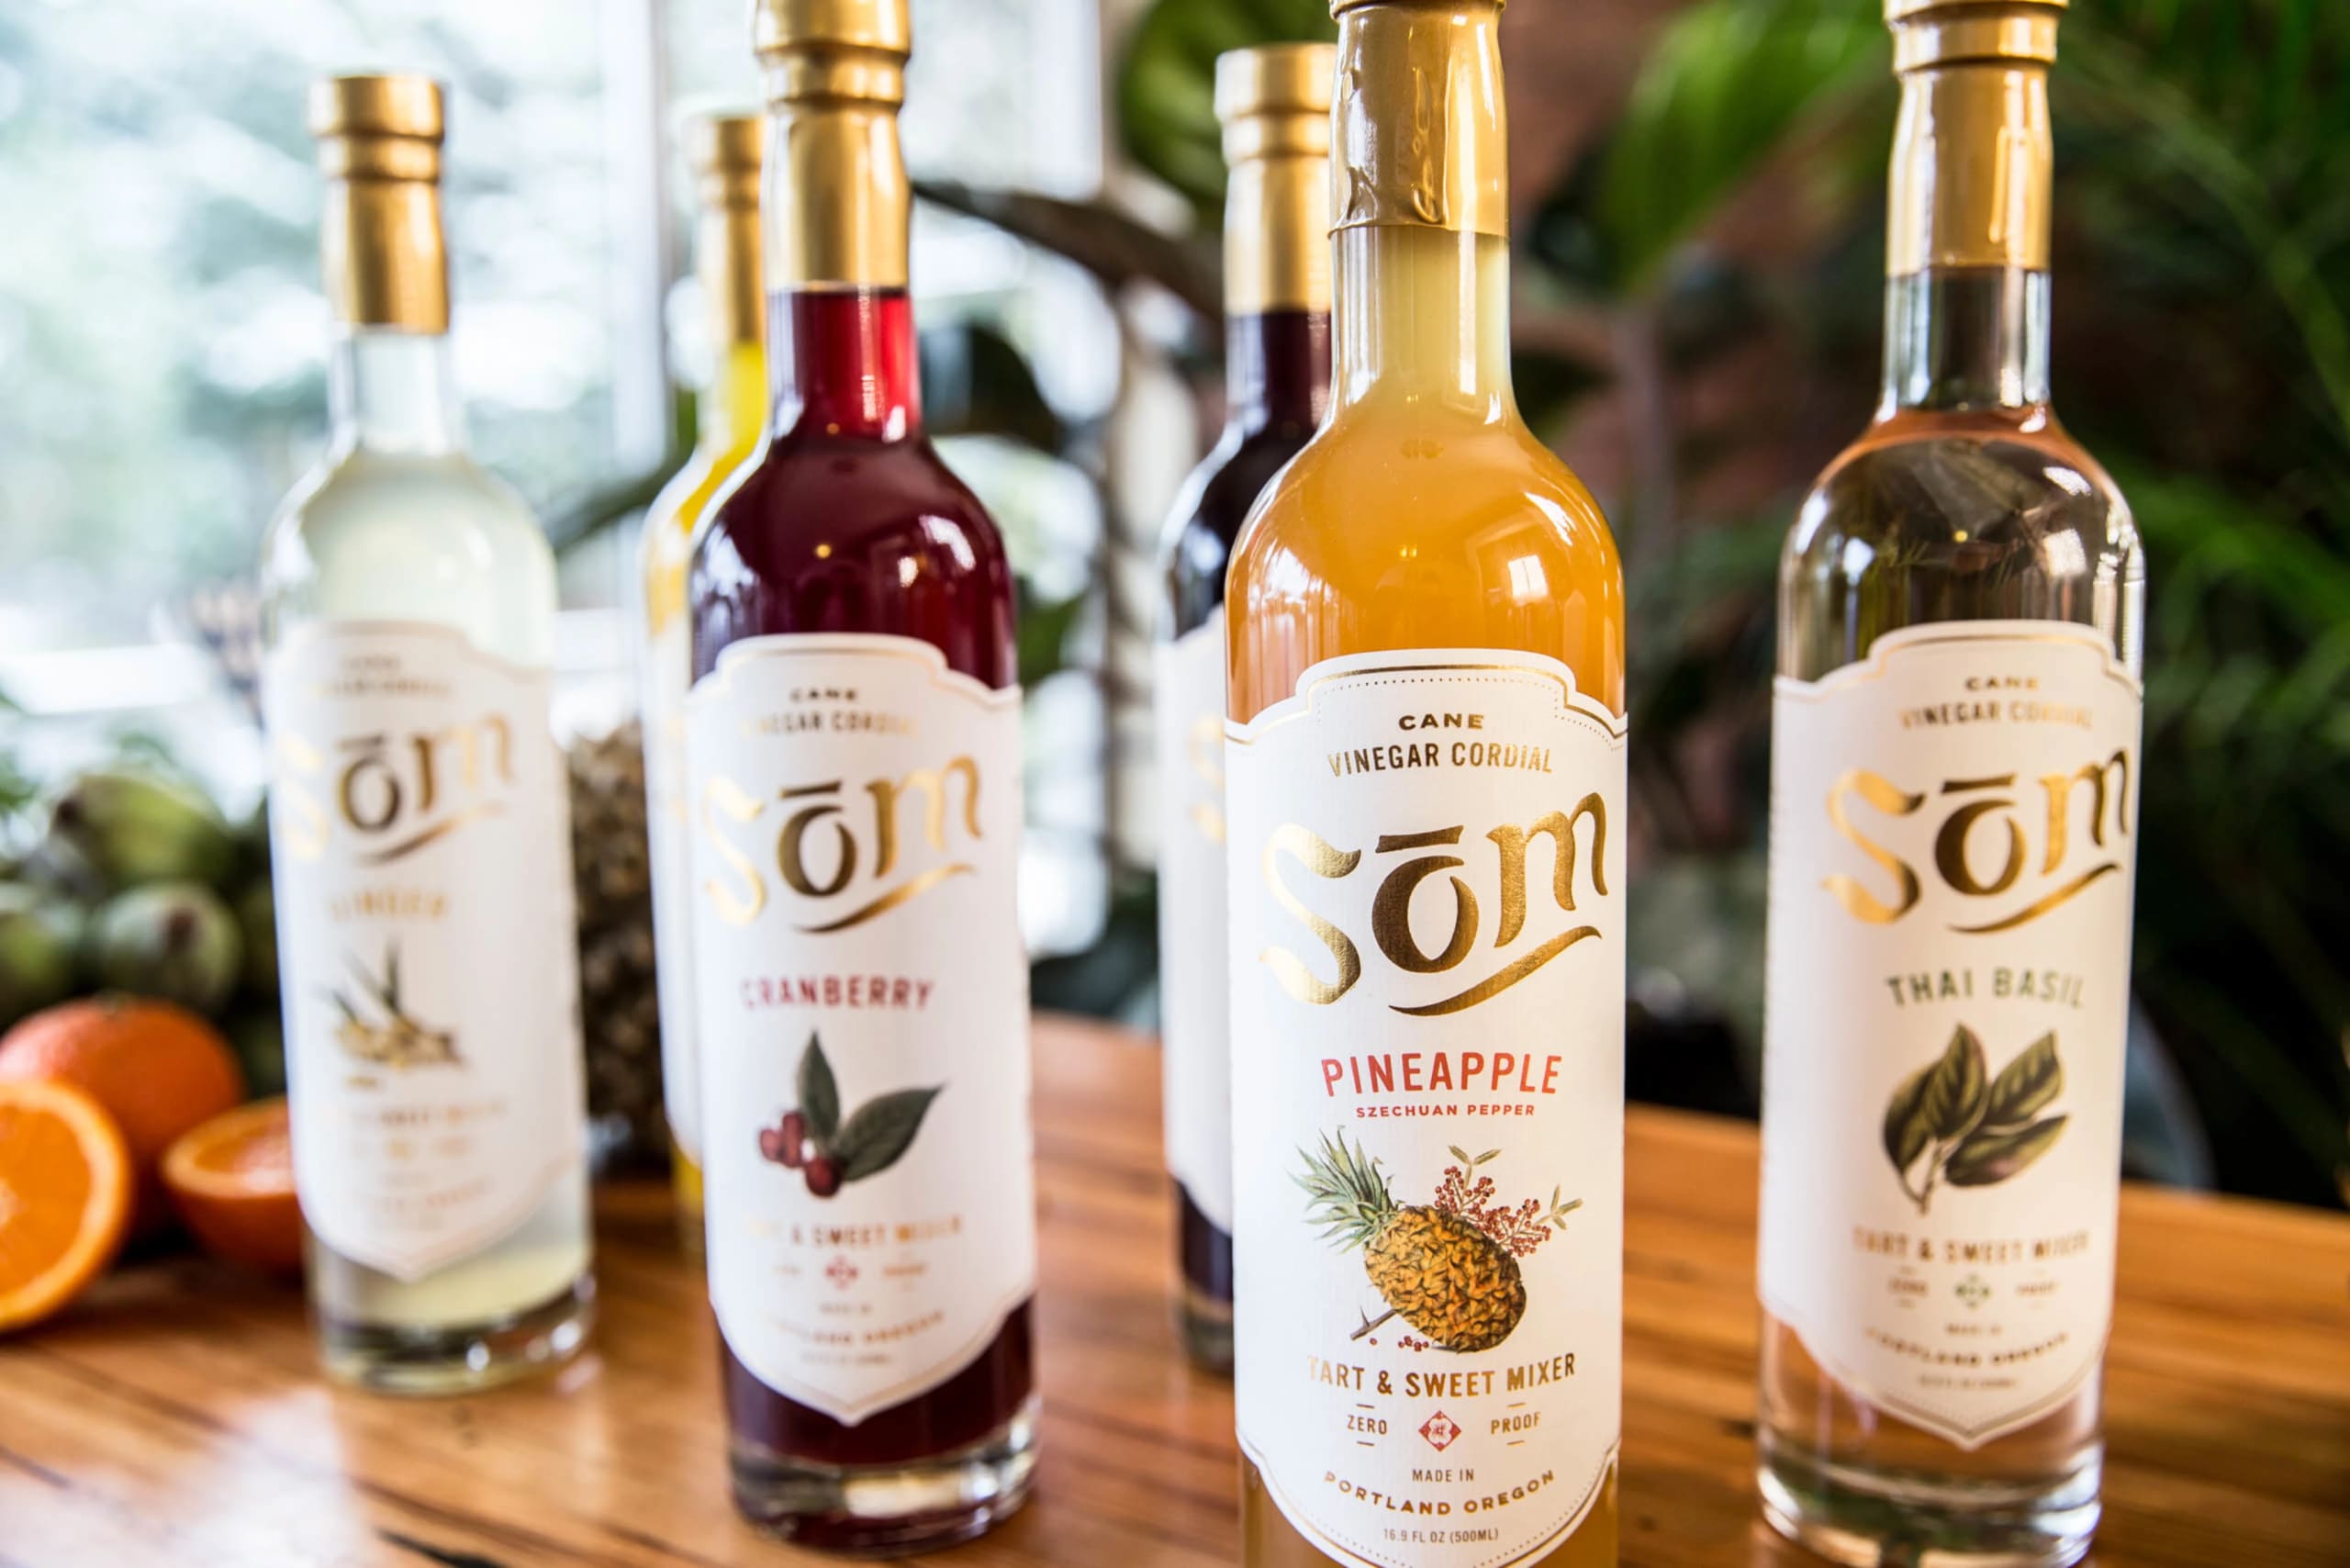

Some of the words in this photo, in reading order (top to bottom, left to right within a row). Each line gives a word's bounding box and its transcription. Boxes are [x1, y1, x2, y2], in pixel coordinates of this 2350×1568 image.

[1964, 675, 2040, 692] CANE
[1398, 712, 1484, 731] CANE
[1898, 700, 2001, 730] VINEGAR
[1326, 742, 1440, 778] VINEGAR
[1450, 741, 1553, 774] CORDIAL
[739, 973, 934, 1011] CRANBERRY
[1884, 969, 1975, 1008] THAI
[1991, 967, 2086, 1009] BASIL
[1320, 1050, 1563, 1097] PINEAPPLE
[1355, 1103, 1460, 1119] SZECHUAN
[1466, 1103, 1536, 1118] PEPPER
[1852, 1226, 1912, 1257] TART
[1918, 1238, 1935, 1263] &
[1944, 1237, 2023, 1265] SWEET
[1306, 1355, 1366, 1392] TART
[1376, 1370, 1393, 1395] &
[1404, 1370, 1496, 1397] SWEET
[1506, 1352, 1576, 1392] MIXER
[1346, 1414, 1388, 1436] ZERO
[1490, 1411, 1542, 1435] PROOF
[1412, 1468, 1453, 1483] MADE
[1459, 1468, 1475, 1483] IN
[1323, 1471, 1452, 1516] PORTLAND
[1463, 1470, 1556, 1515] OREGON
[1383, 1528, 1409, 1543] 16.9
[1412, 1529, 1426, 1543] FL
[1429, 1529, 1447, 1543] OZ
[1449, 1528, 1500, 1544] (500ML)
